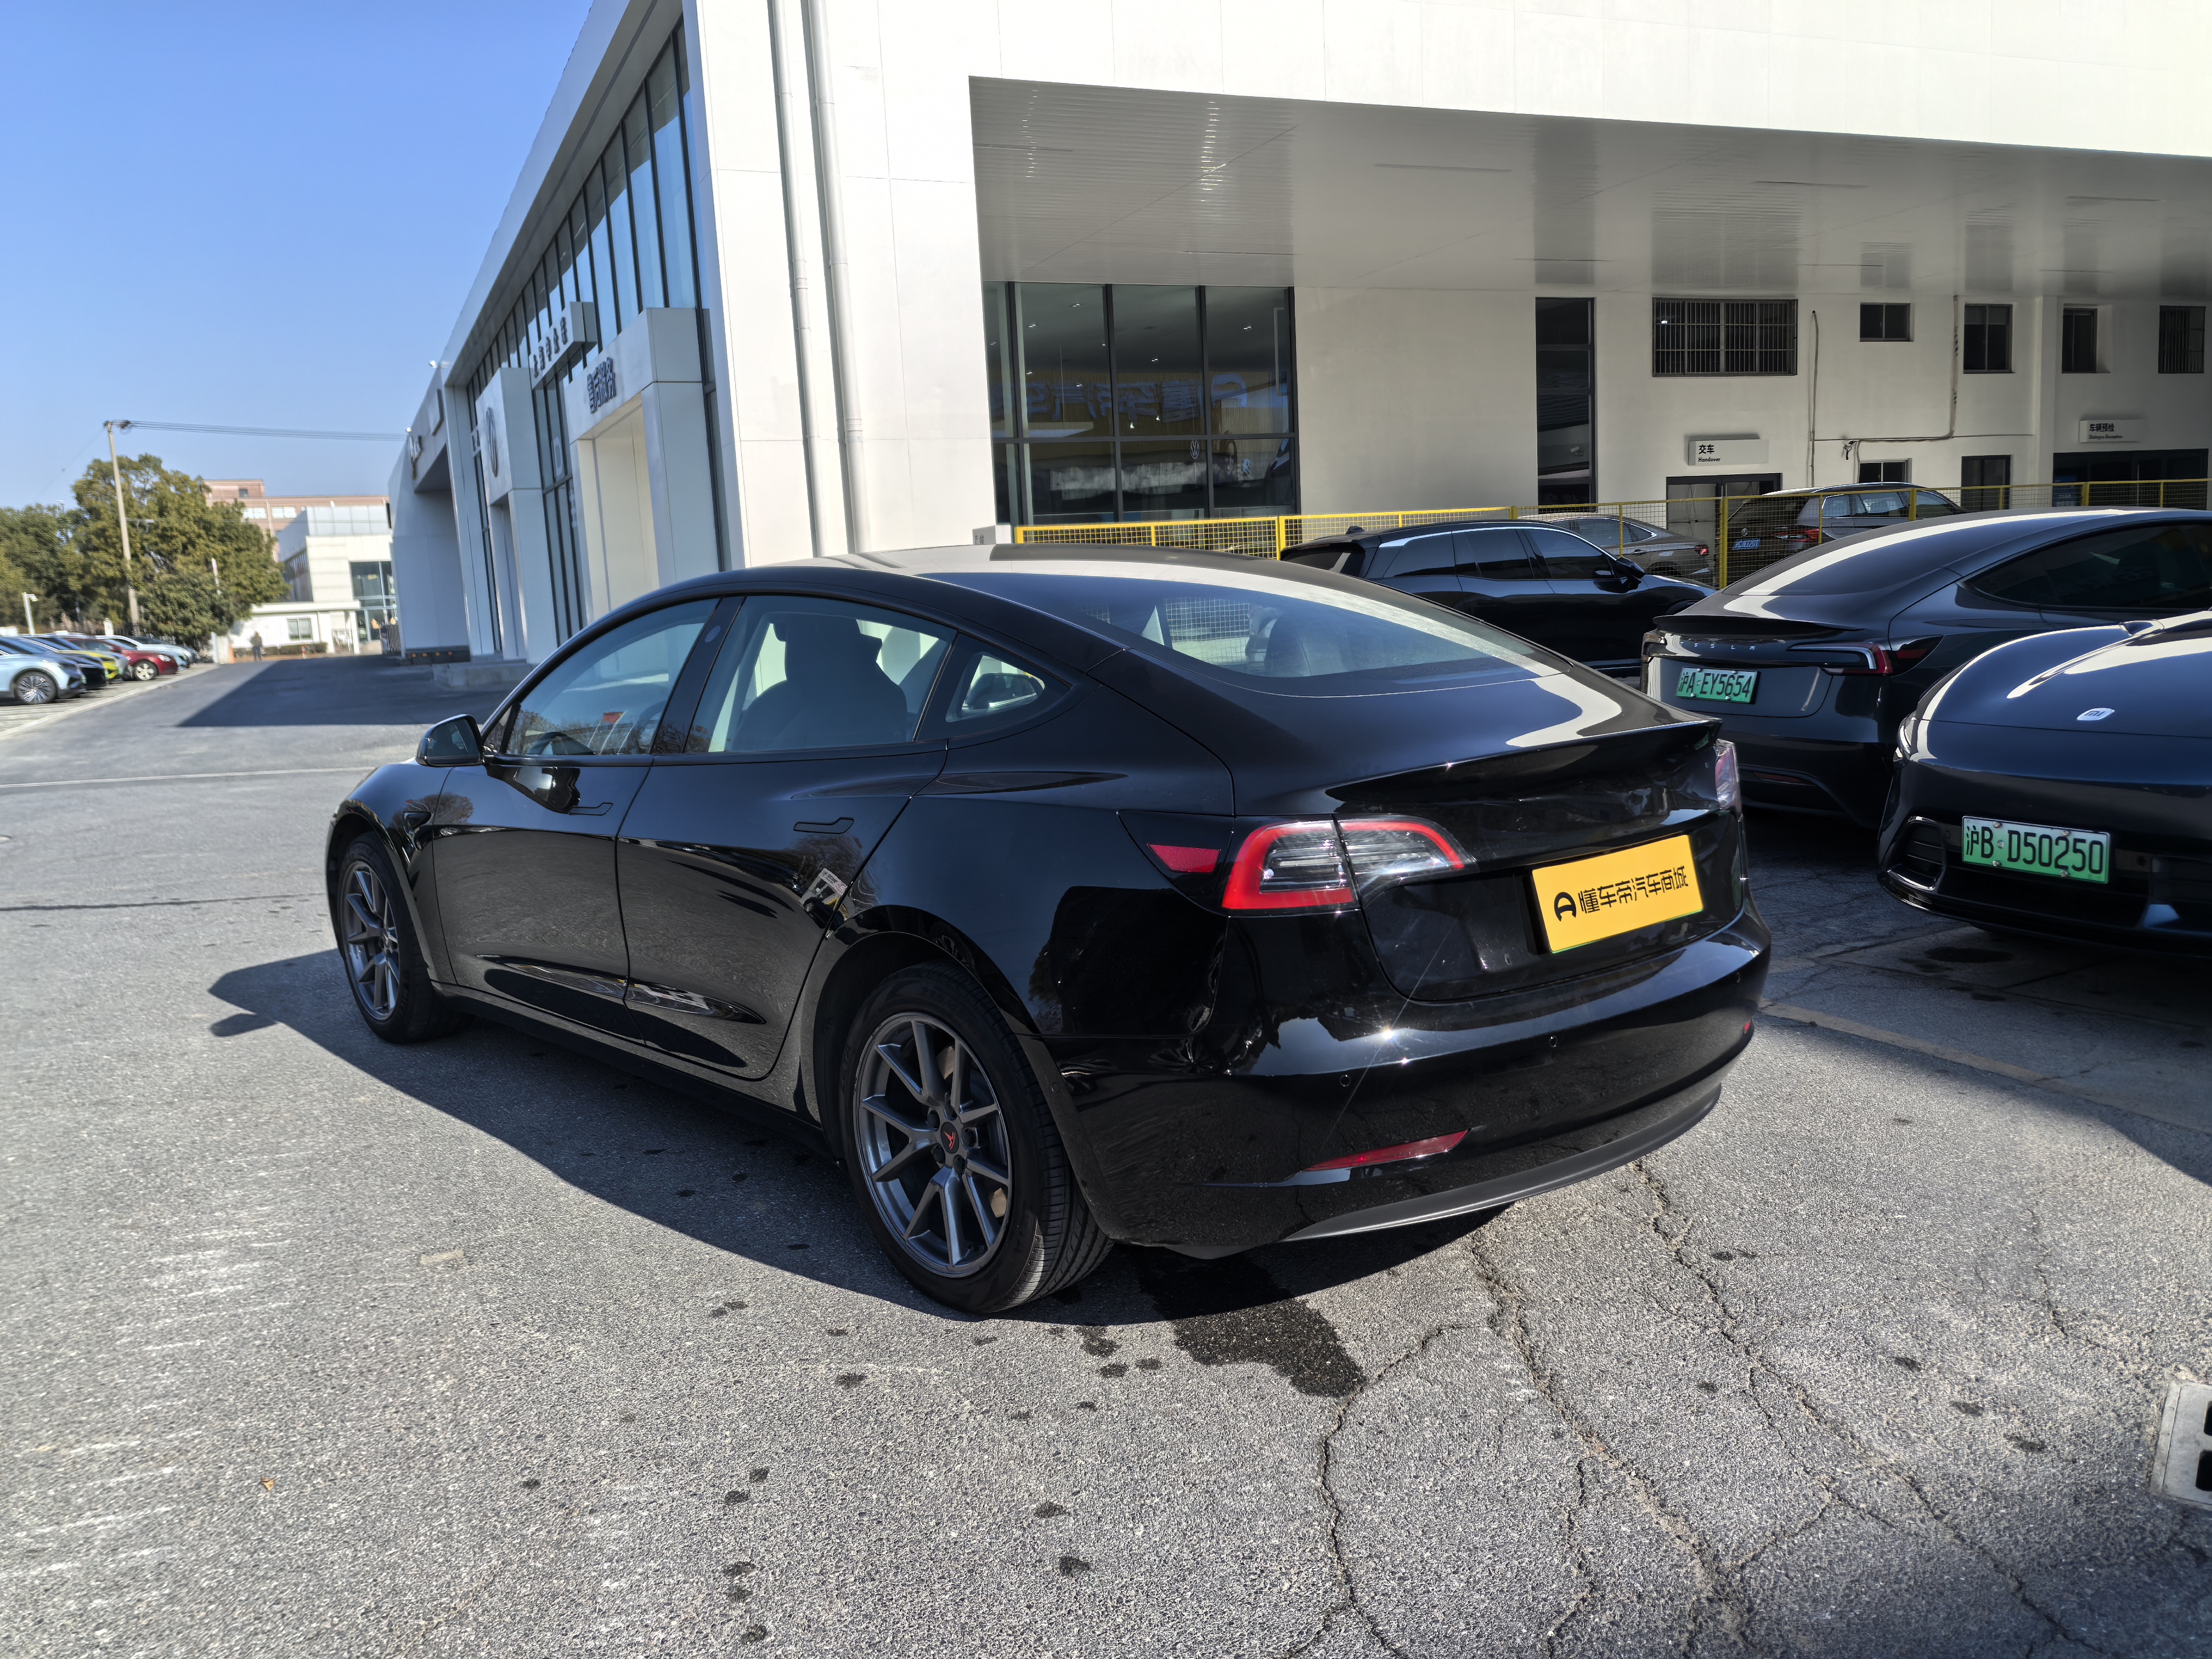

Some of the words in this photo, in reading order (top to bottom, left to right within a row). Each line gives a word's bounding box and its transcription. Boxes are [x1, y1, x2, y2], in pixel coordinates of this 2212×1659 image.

[586, 357, 616, 414] 售后服务
[1698, 444, 1715, 454] 交车
[1578, 865, 1689, 914] 懂车帝汽车商城
